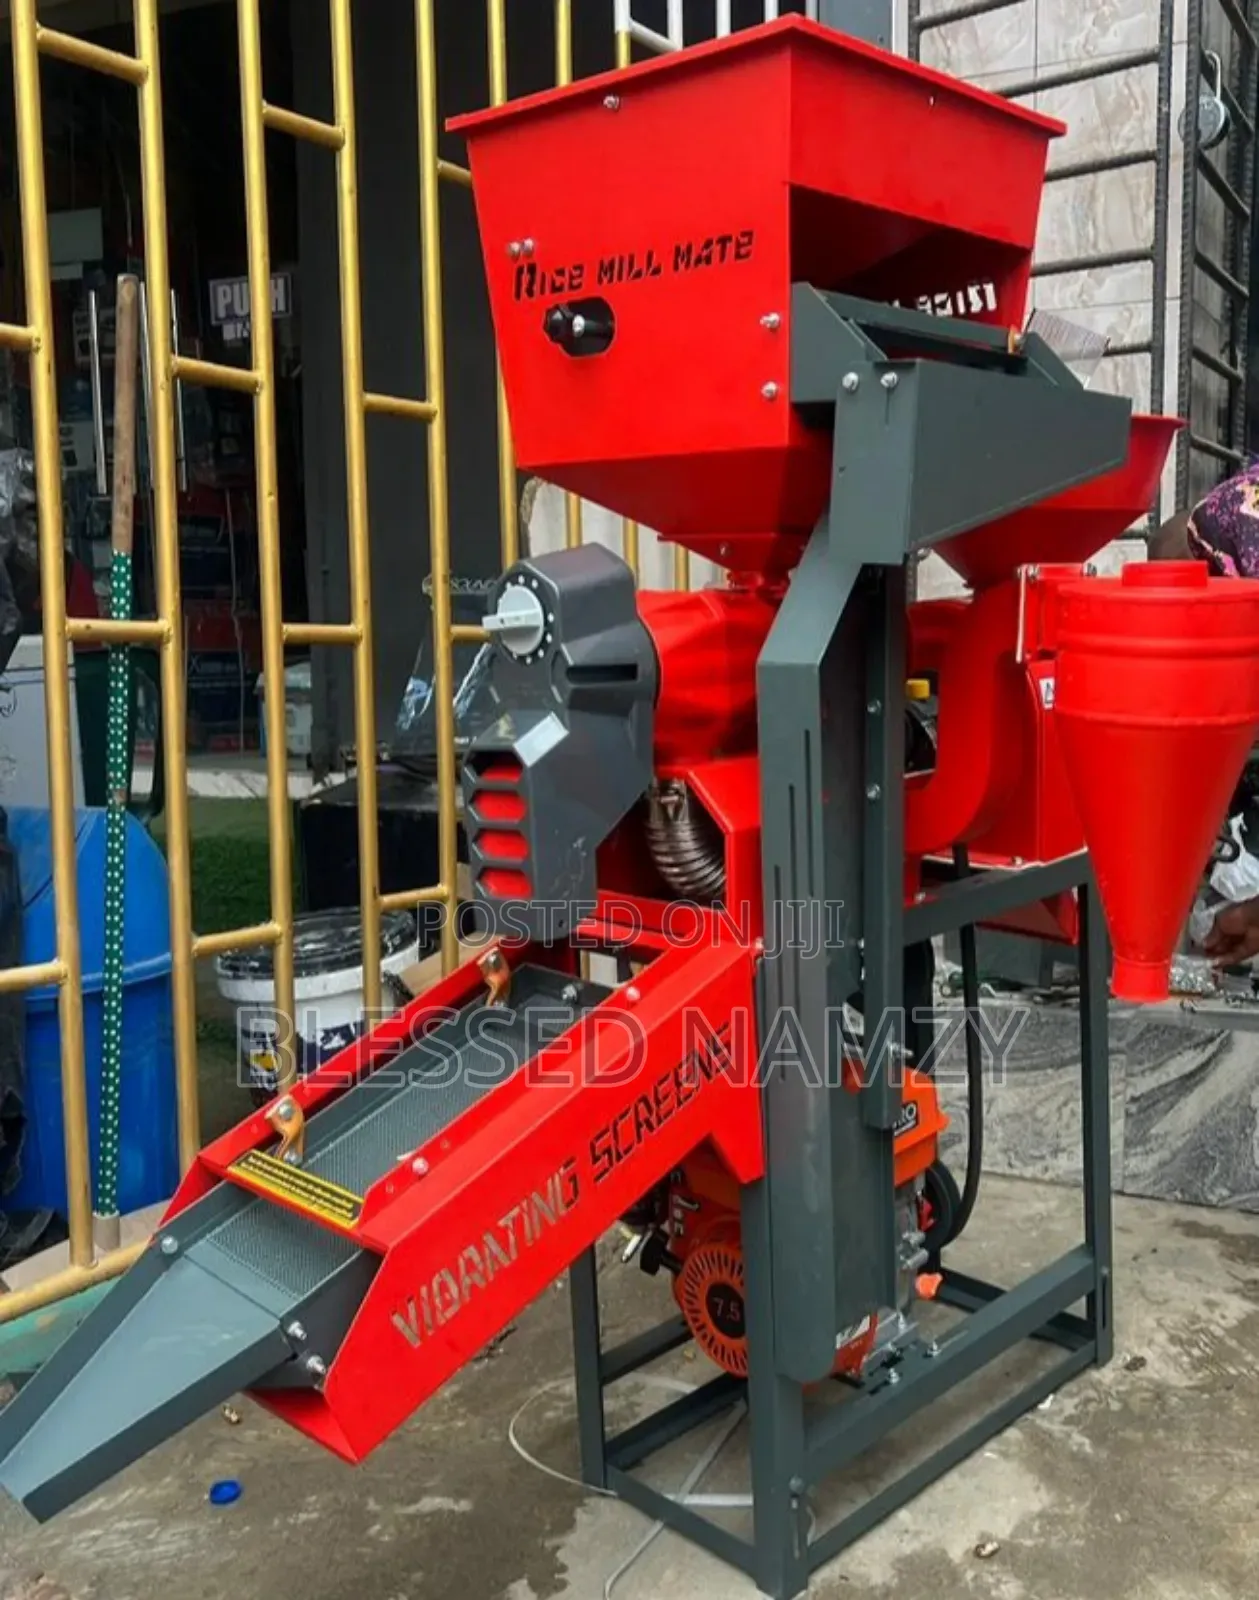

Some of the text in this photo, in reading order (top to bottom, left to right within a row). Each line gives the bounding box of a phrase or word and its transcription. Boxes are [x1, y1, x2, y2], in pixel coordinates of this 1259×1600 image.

[597, 249, 662, 286] MILL
[673, 230, 754, 272] MATE
[217, 278, 285, 318] PUH
[390, 1155, 581, 1349] VIBRATING
[714, 1298, 741, 1322] 7.5
